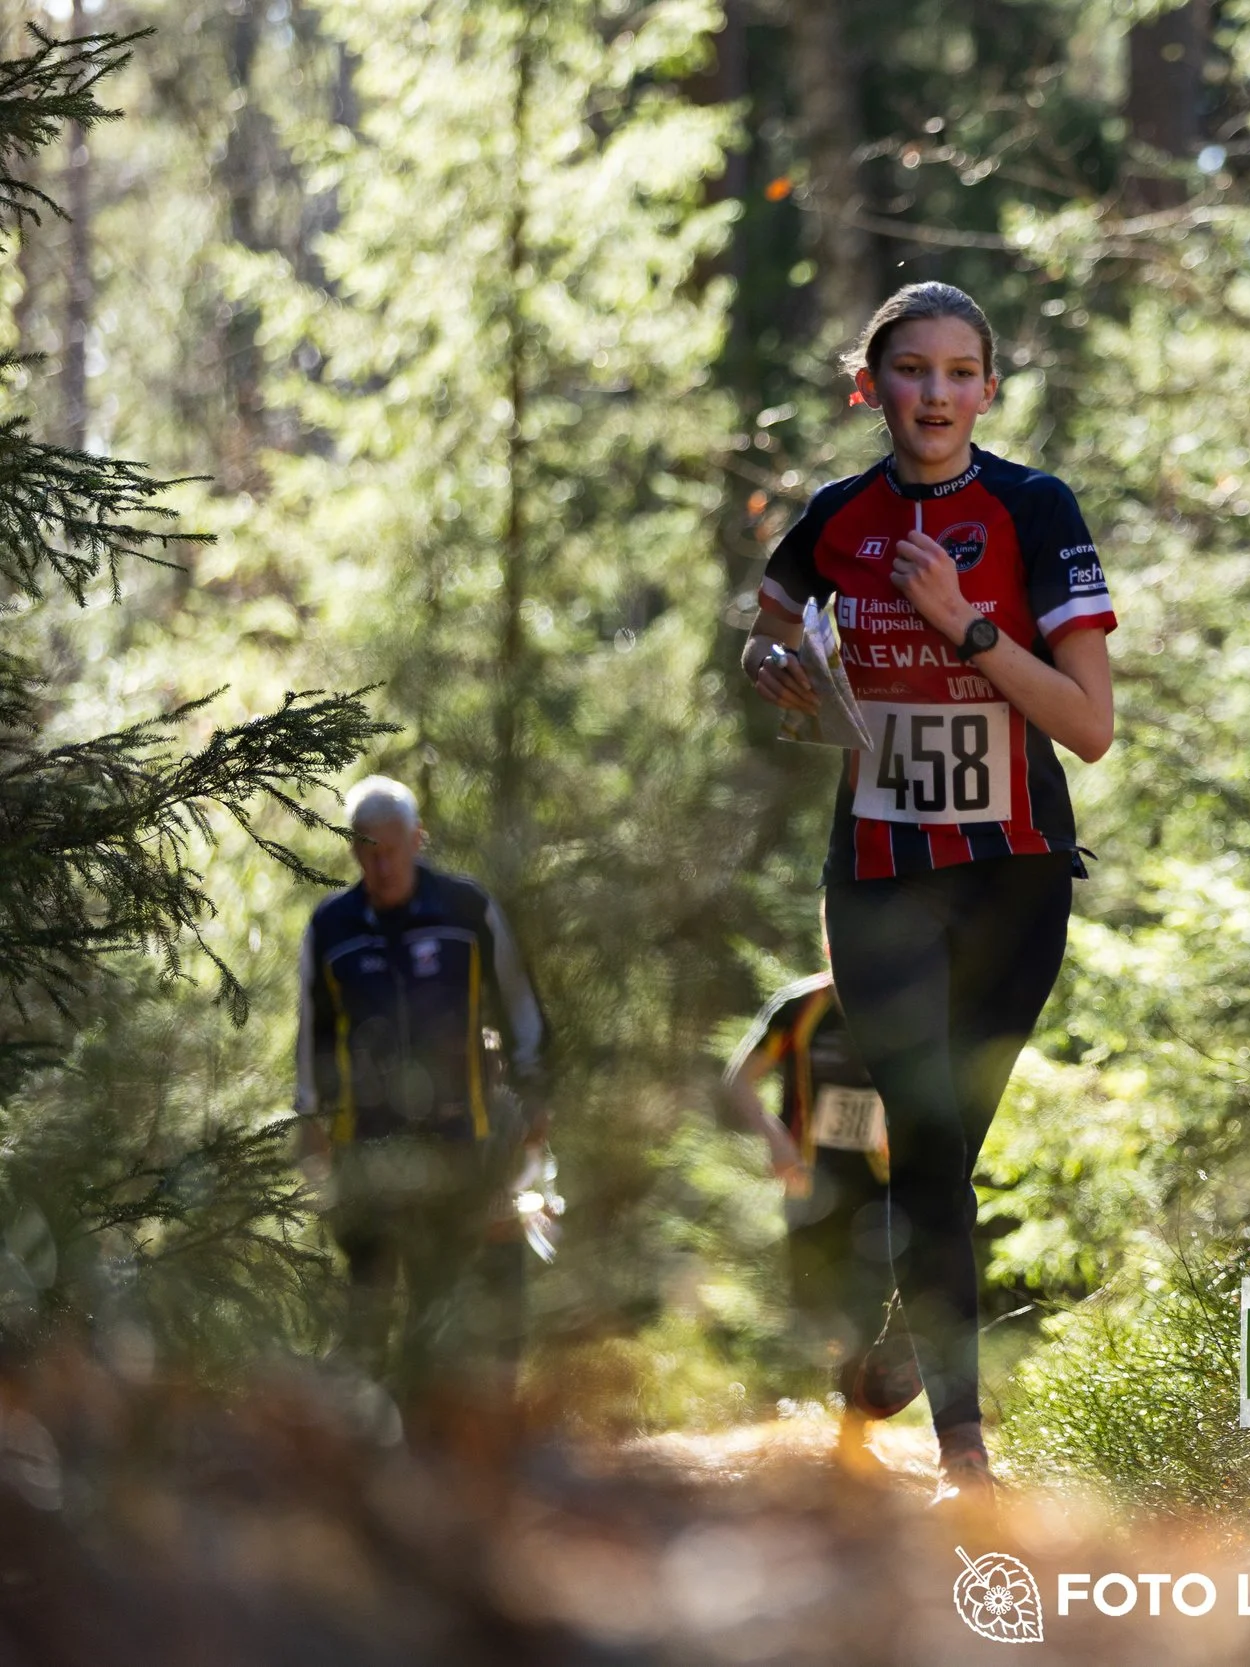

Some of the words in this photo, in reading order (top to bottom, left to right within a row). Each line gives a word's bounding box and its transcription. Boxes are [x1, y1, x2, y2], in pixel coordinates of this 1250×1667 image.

[934, 459, 982, 497] UPPSALA
[861, 615, 924, 634] Uppsala
[842, 643, 978, 668] ALEWAL
[876, 713, 990, 812] 458
